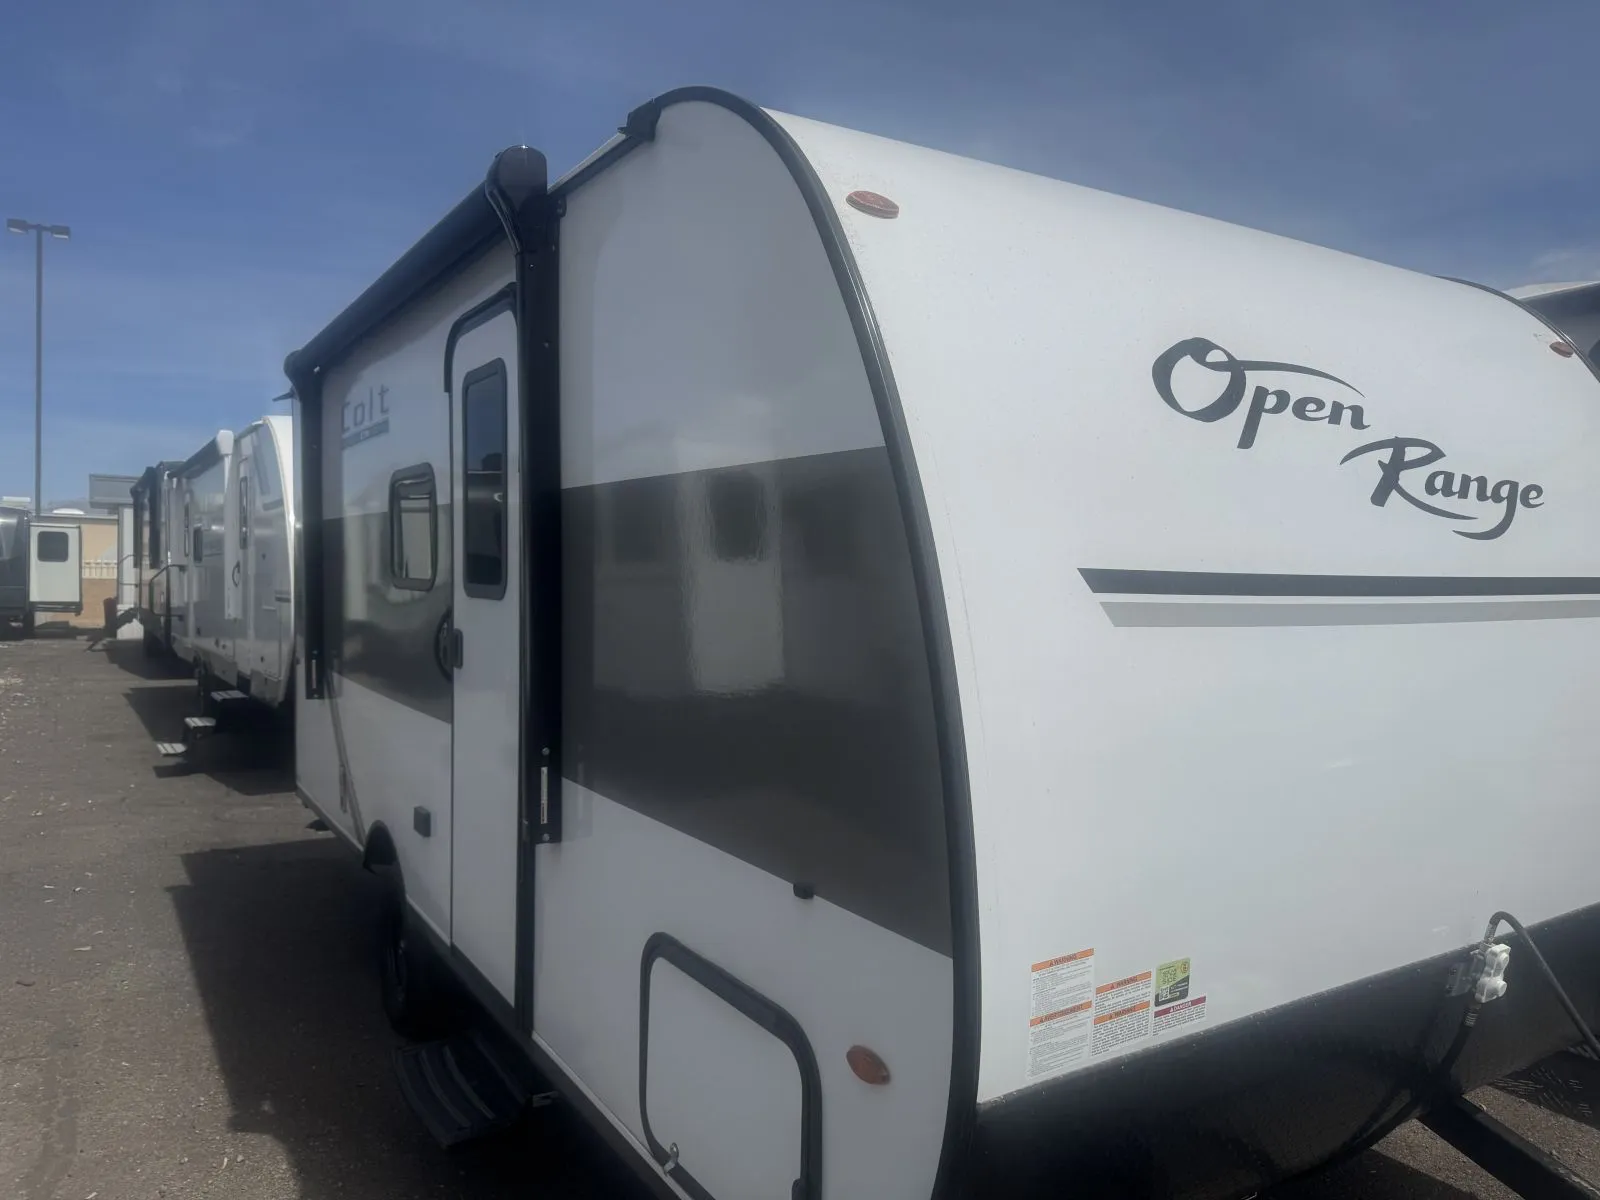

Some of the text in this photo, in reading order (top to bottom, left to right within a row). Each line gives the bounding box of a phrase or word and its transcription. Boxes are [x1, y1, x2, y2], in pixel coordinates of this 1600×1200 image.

[341, 384, 390, 434] Colt
[1152, 337, 1371, 449] Open
[1340, 436, 1545, 541] Range
[1173, 1001, 1192, 1012] DANGER
